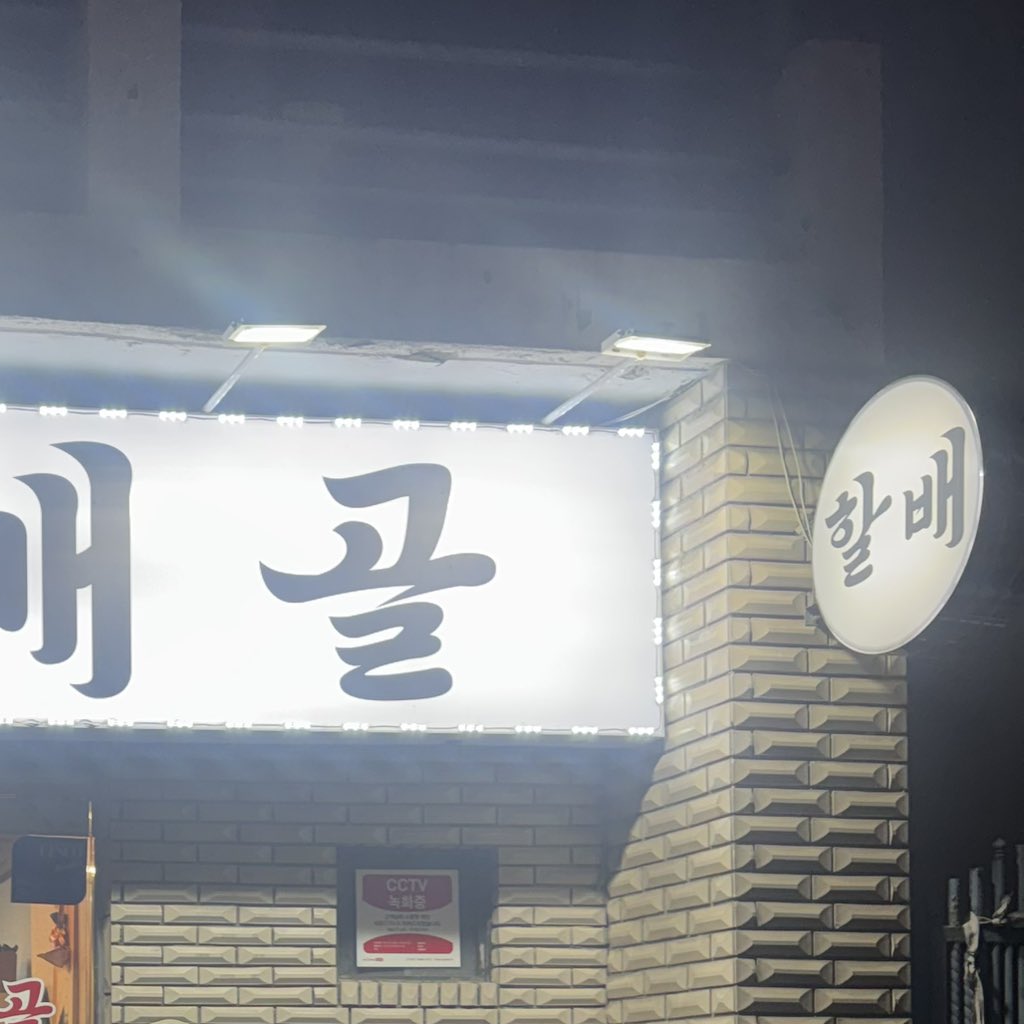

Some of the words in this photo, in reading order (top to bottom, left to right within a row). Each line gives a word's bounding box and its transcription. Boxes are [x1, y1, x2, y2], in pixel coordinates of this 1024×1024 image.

[825, 426, 965, 587] 할배
[386, 878, 428, 892] CCTV
[389, 894, 427, 910] 녹화중
